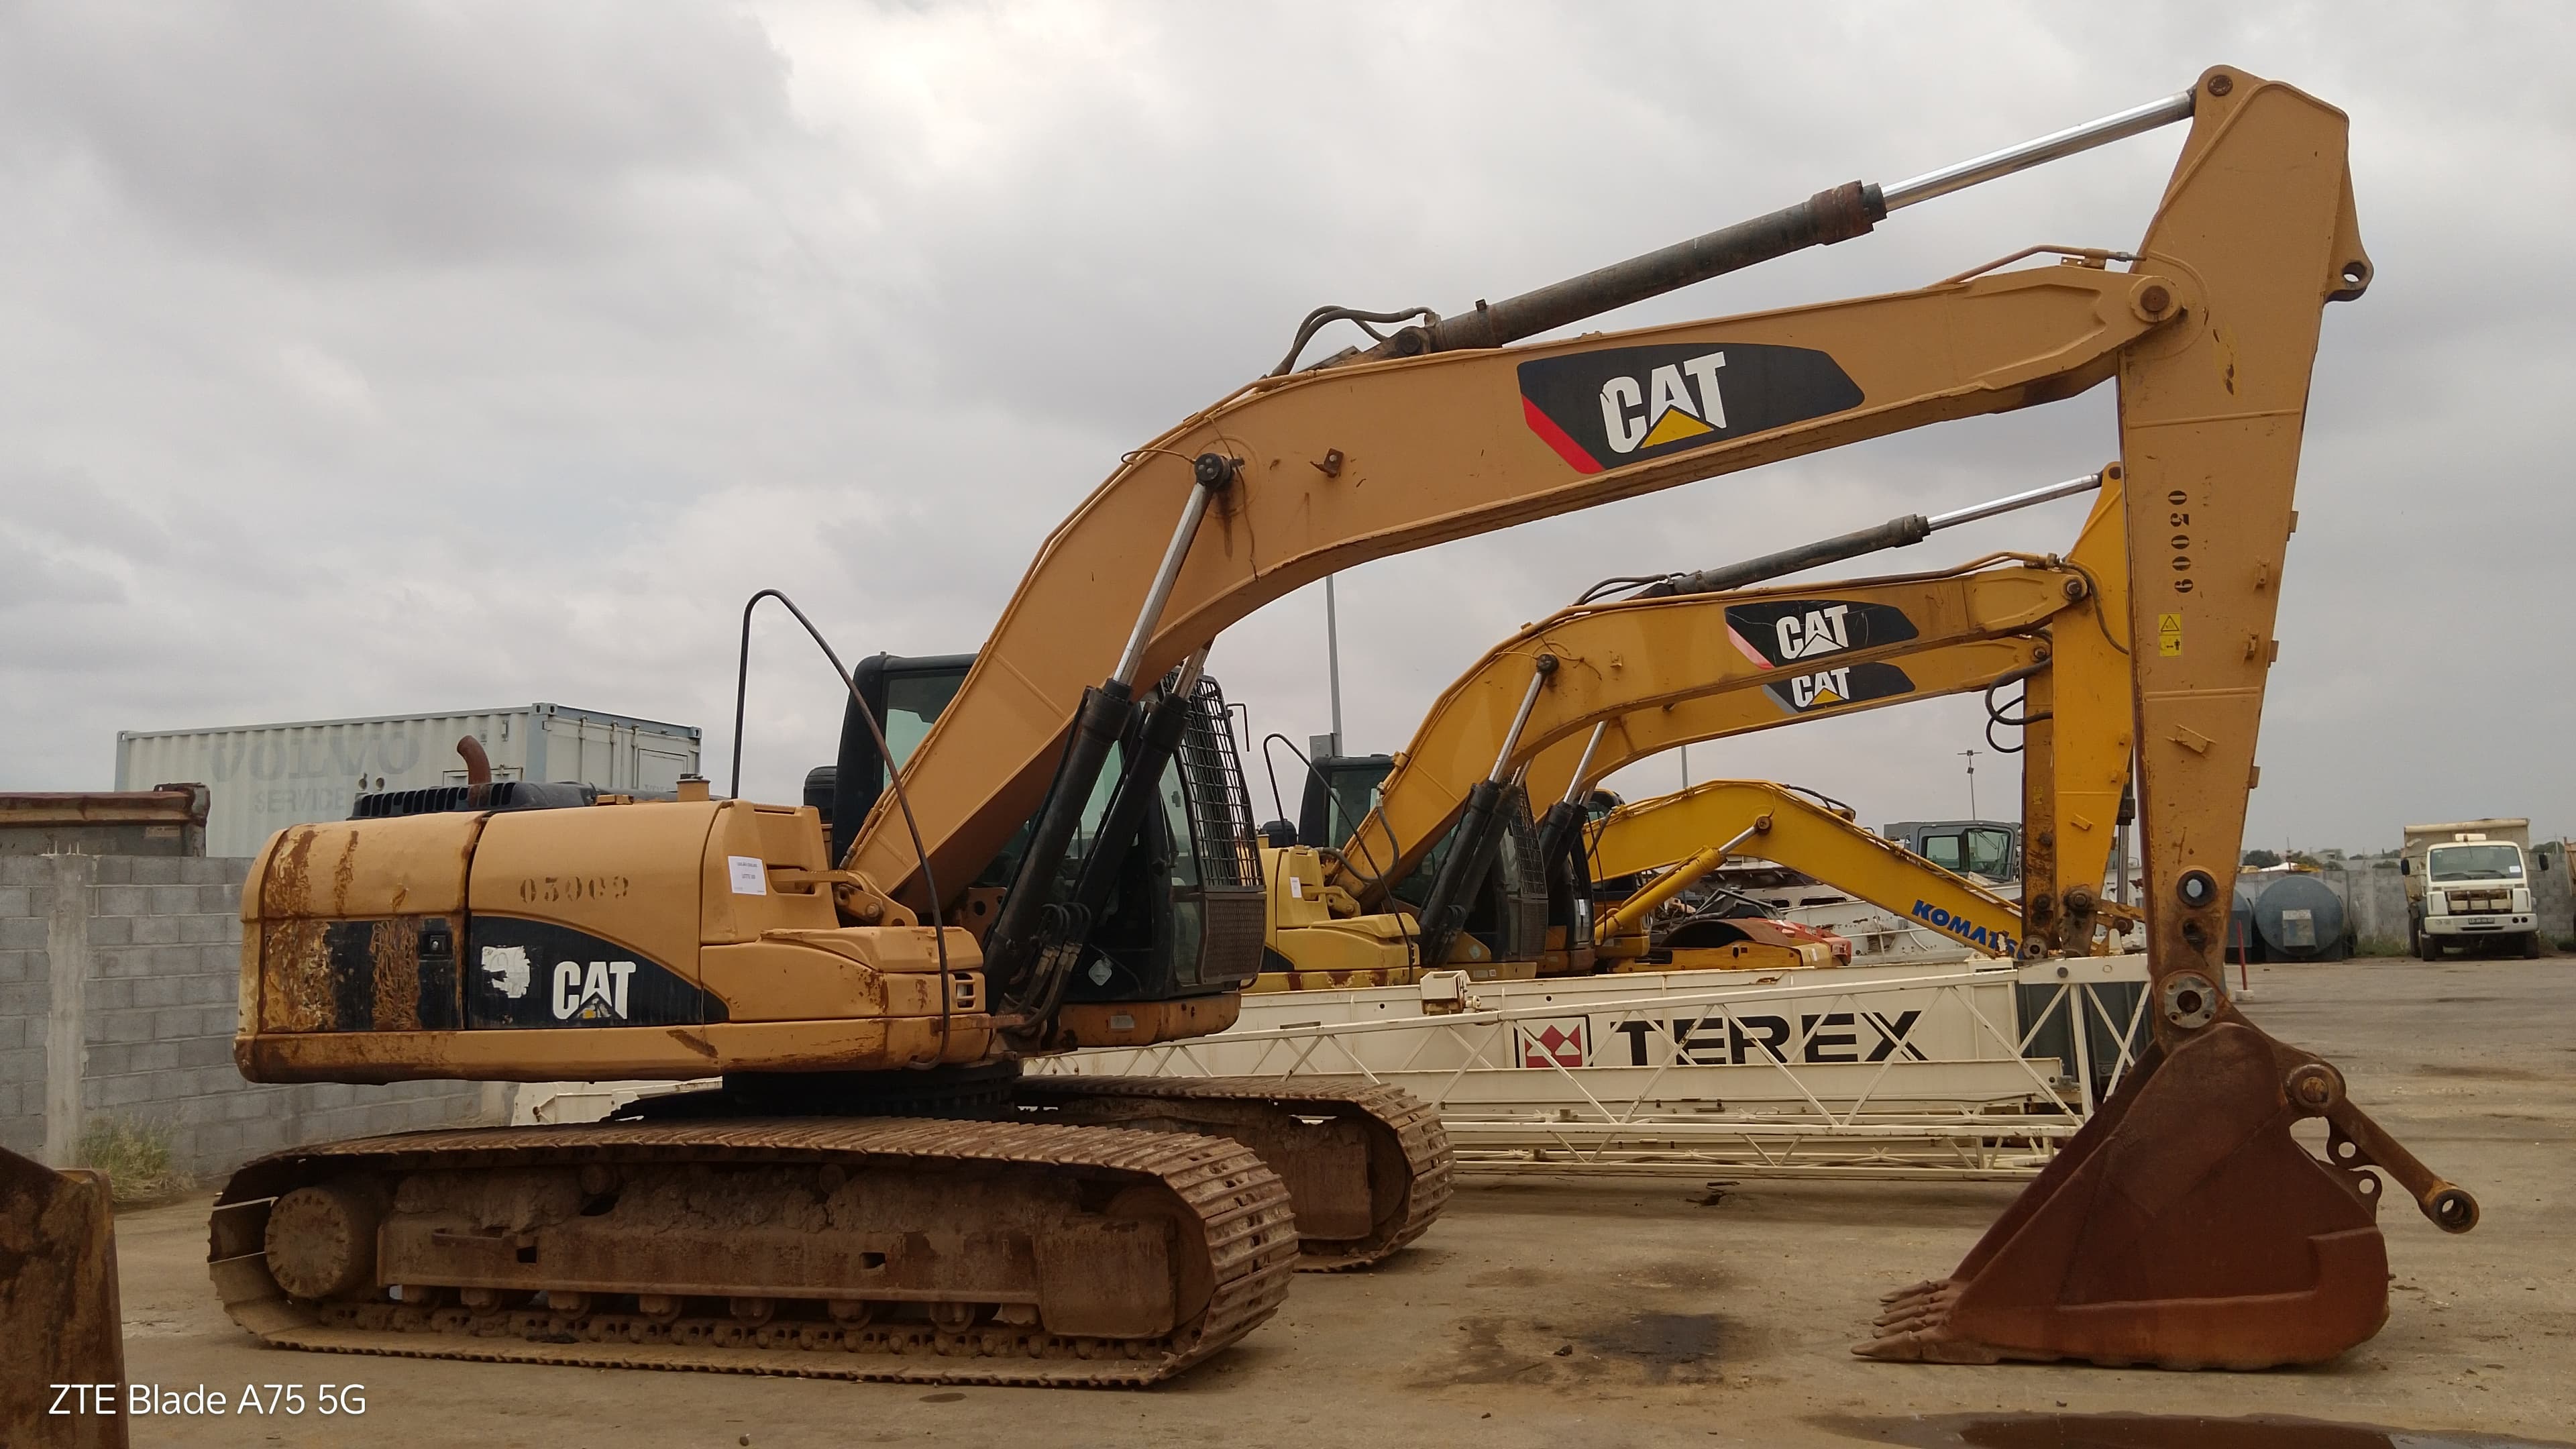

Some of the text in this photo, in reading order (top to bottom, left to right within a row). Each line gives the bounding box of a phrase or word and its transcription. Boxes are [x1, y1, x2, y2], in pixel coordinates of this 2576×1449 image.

[1600, 351, 1727, 453] CAT
[2168, 490, 2194, 593] 05009
[1776, 604, 1849, 659] CAT
[1791, 667, 1850, 708] CAT
[203, 730, 421, 783] VOLVO
[553, 961, 637, 1020] CAT
[1611, 1010, 1929, 1065] TEREX
